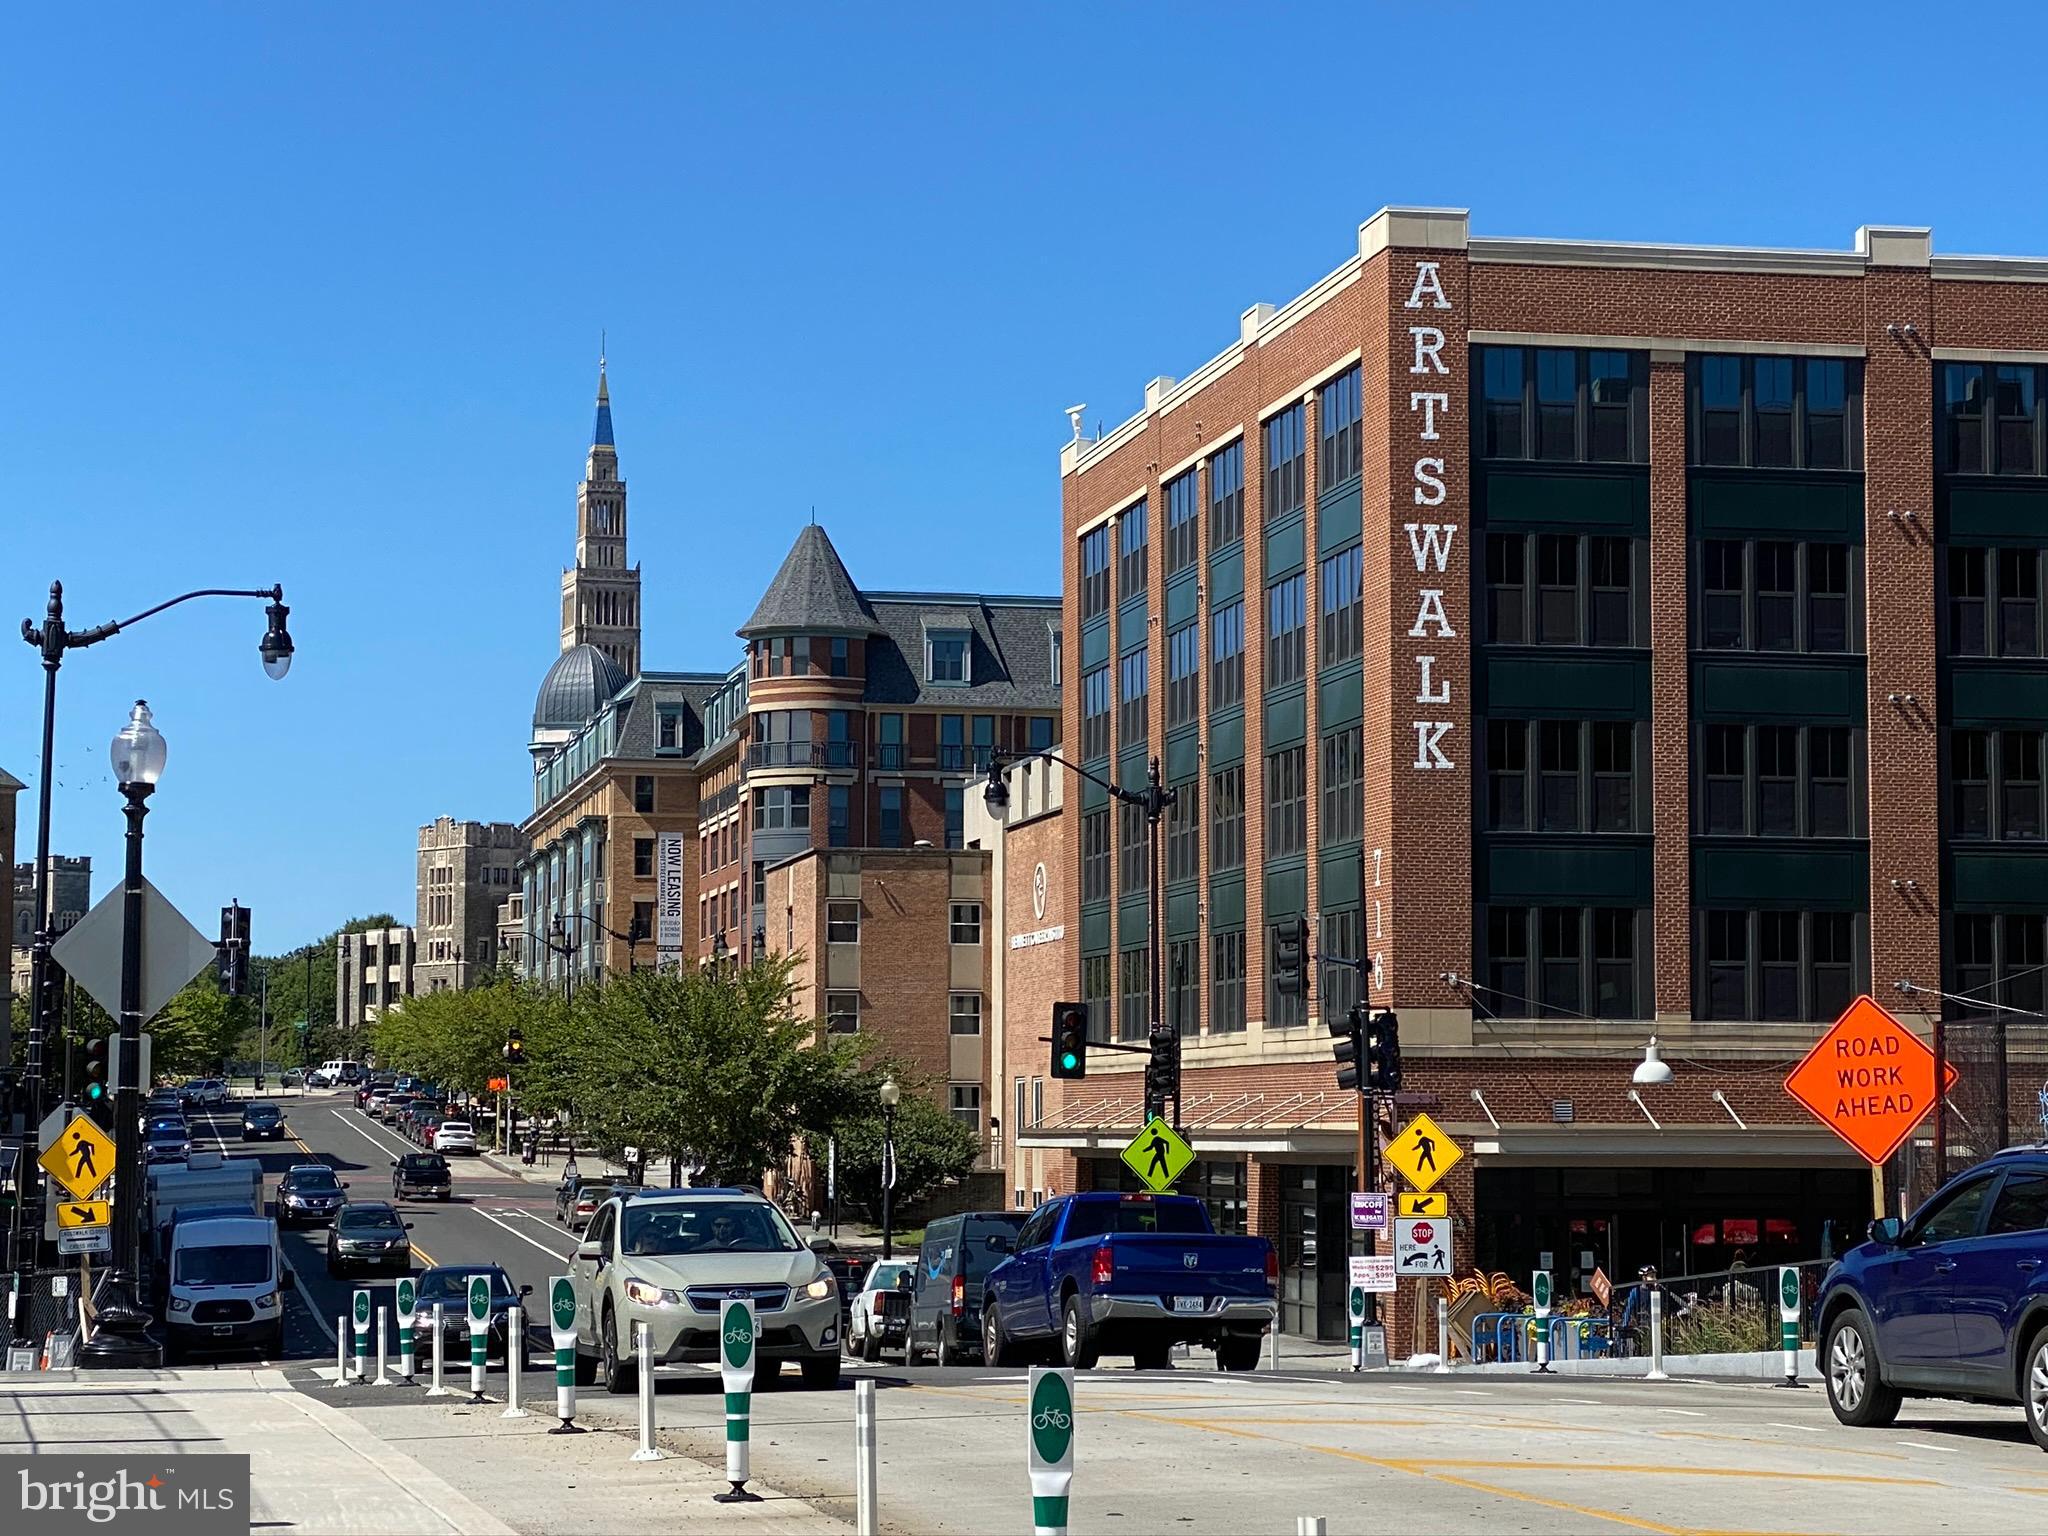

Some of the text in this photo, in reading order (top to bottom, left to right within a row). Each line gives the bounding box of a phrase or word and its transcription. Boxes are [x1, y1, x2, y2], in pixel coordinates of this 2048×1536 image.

[1404, 261, 1458, 769] ARTSWALK
[667, 839, 681, 917] NOW LEASING
[1836, 1036, 1899, 1058] ROAD
[1837, 1066, 1904, 1088] WORK
[1835, 1094, 1913, 1119] AHEAD
[1412, 1228, 1433, 1238] STOP
